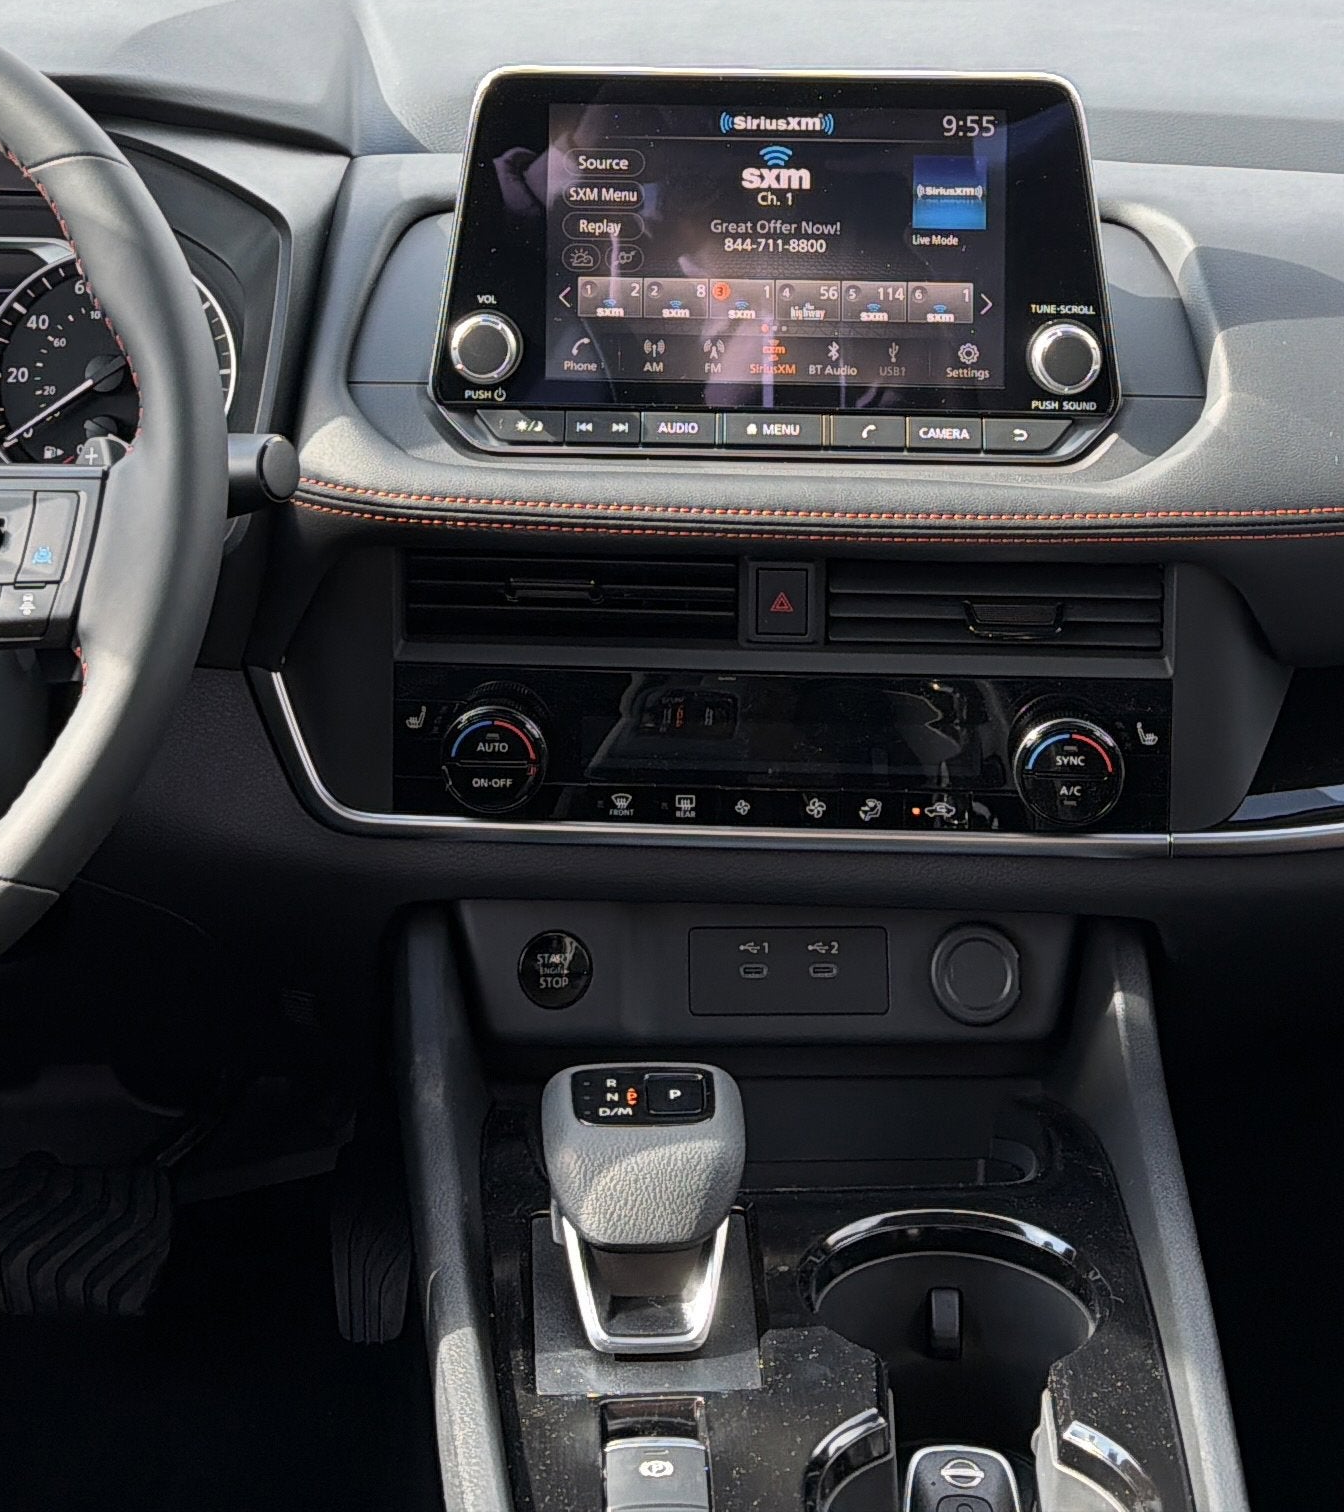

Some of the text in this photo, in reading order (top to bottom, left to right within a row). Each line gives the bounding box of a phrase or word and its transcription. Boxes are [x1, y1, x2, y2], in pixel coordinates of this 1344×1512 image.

[942, 115, 996, 138] 9:55
[578, 155, 629, 170] Source
[741, 167, 811, 190] sxm
[569, 187, 638, 202] SXM Menu
[757, 191, 793, 206] Ch. 1
[578, 219, 622, 237] Replay
[710, 219, 842, 236] Great Offer Now!
[723, 237, 827, 254] 844-711-8800
[912, 234, 959, 246] Live Mode
[476, 294, 497, 305] VOL
[630, 283, 641, 297] 2
[650, 284, 659, 297] 2
[696, 284, 707, 298] 8
[764, 285, 771, 299] 1
[781, 287, 790, 299] 4
[819, 286, 839, 301] 56
[848, 288, 857, 300] 5
[877, 287, 905, 301] 114
[914, 289, 923, 301] 6
[962, 288, 970, 303] 1
[26, 314, 50, 330] 40
[53, 337, 67, 348] 60
[7, 367, 29, 384] 20
[563, 360, 598, 372] Phone
[643, 361, 664, 373] AM
[704, 362, 722, 374] FM
[749, 363, 796, 375] SiriusXM
[808, 364, 823, 376] BT
[824, 364, 858, 376] Audio
[946, 367, 990, 381] Settings
[42, 385, 56, 396] 20
[464, 389, 492, 400] PUSH
[1031, 399, 1097, 411] PUSH SOUND
[657, 421, 699, 435] AUDIO
[762, 423, 801, 437] MENU
[918, 427, 970, 441] CAMERA
[476, 741, 509, 753] AUTO
[1055, 755, 1086, 767] SYNC
[1059, 785, 1082, 796] A/C
[609, 808, 696, 819] FRONT REAR
[830, 941, 839, 954] 2
[539, 976, 569, 989] STOP
[606, 1078, 617, 1088] R
[606, 1092, 619, 1102] N
[668, 1089, 682, 1100] P
[598, 1107, 633, 1117] D/M
